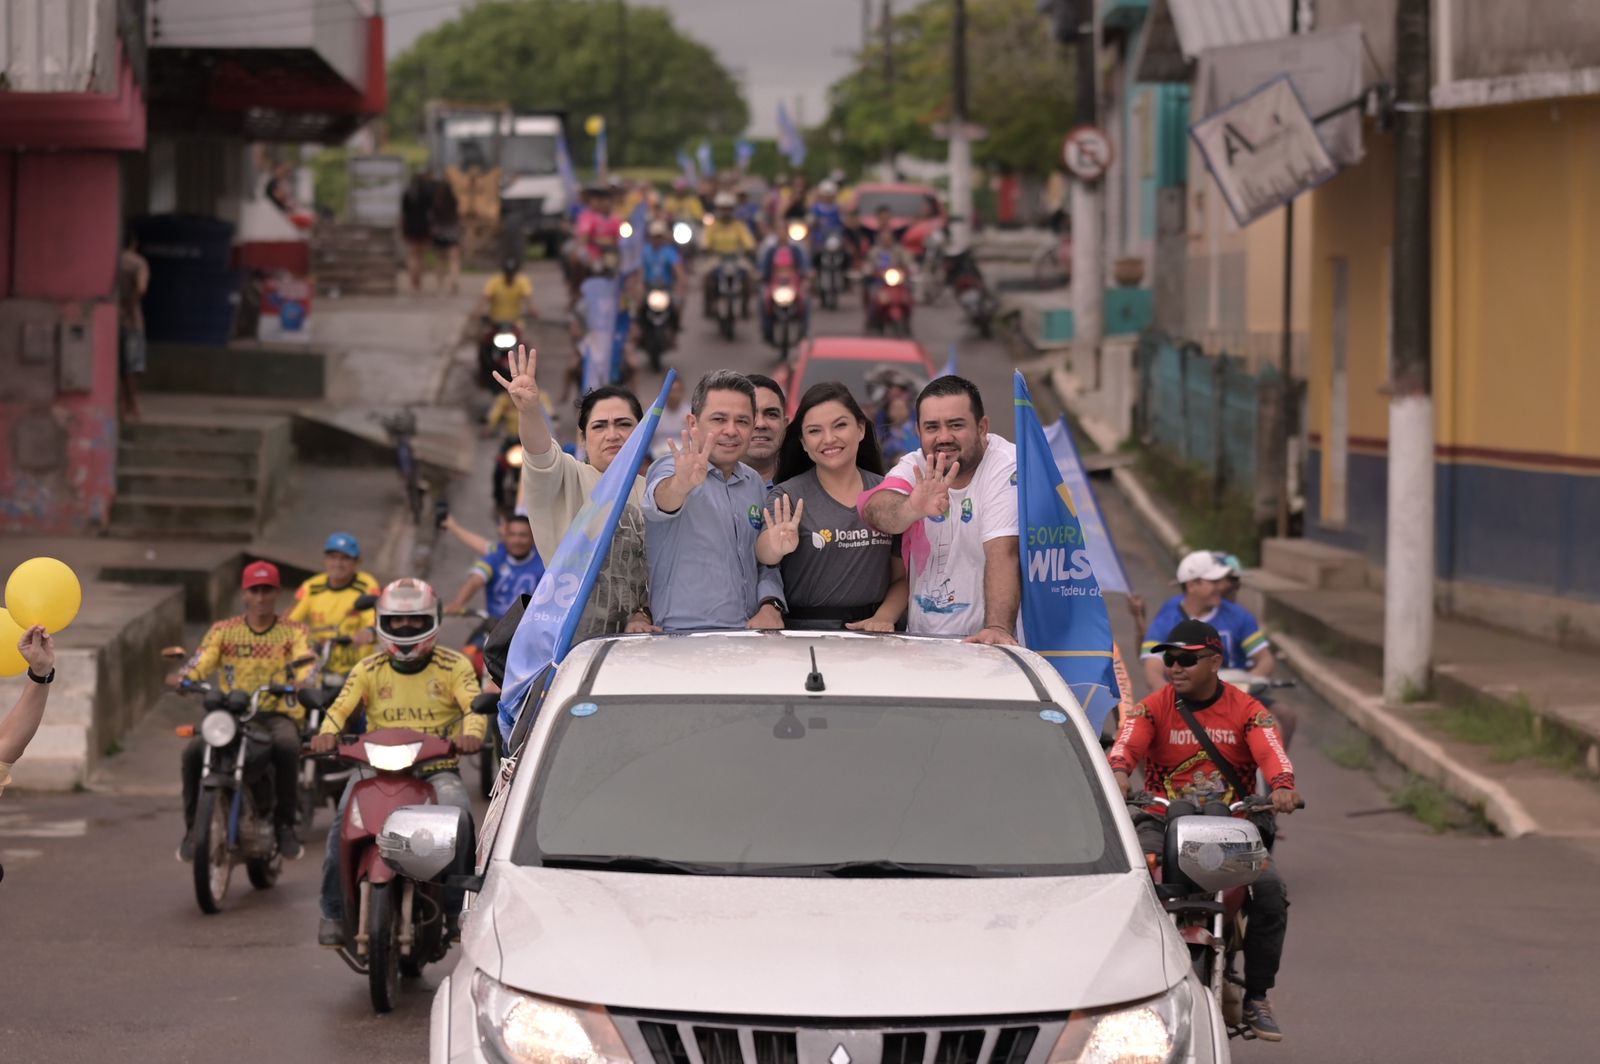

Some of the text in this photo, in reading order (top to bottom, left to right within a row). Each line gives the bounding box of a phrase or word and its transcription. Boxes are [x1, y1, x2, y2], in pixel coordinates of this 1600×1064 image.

[834, 528, 869, 543] Joana
[838, 540, 870, 549] Deputada
[383, 707, 436, 722] GEMA
